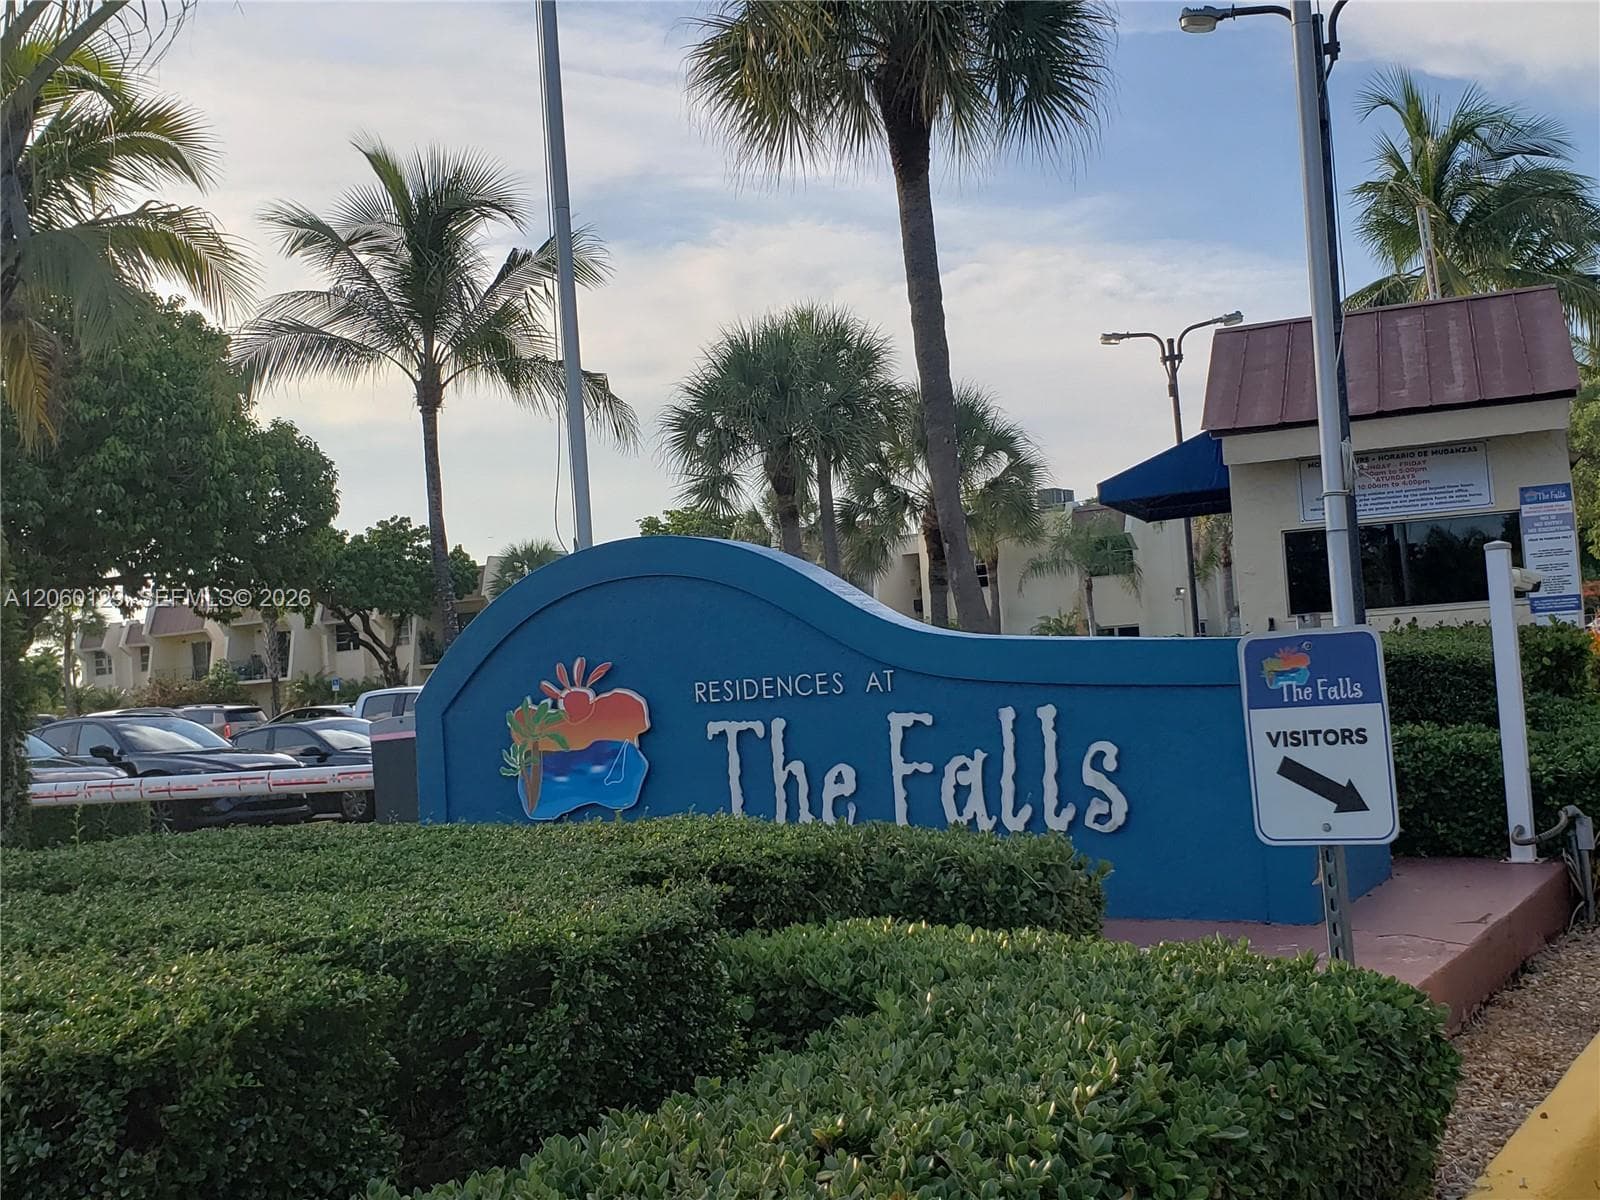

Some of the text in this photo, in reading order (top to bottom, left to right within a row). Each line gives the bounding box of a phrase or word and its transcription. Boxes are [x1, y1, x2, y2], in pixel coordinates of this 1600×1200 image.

[1372, 473, 1416, 484] ATURDAYS
[694, 670, 894, 704] RESIDENCES AT
[1278, 677, 1363, 702] The Falls
[1265, 727, 1368, 748] VISITORS
[707, 704, 1130, 834] The Falls
